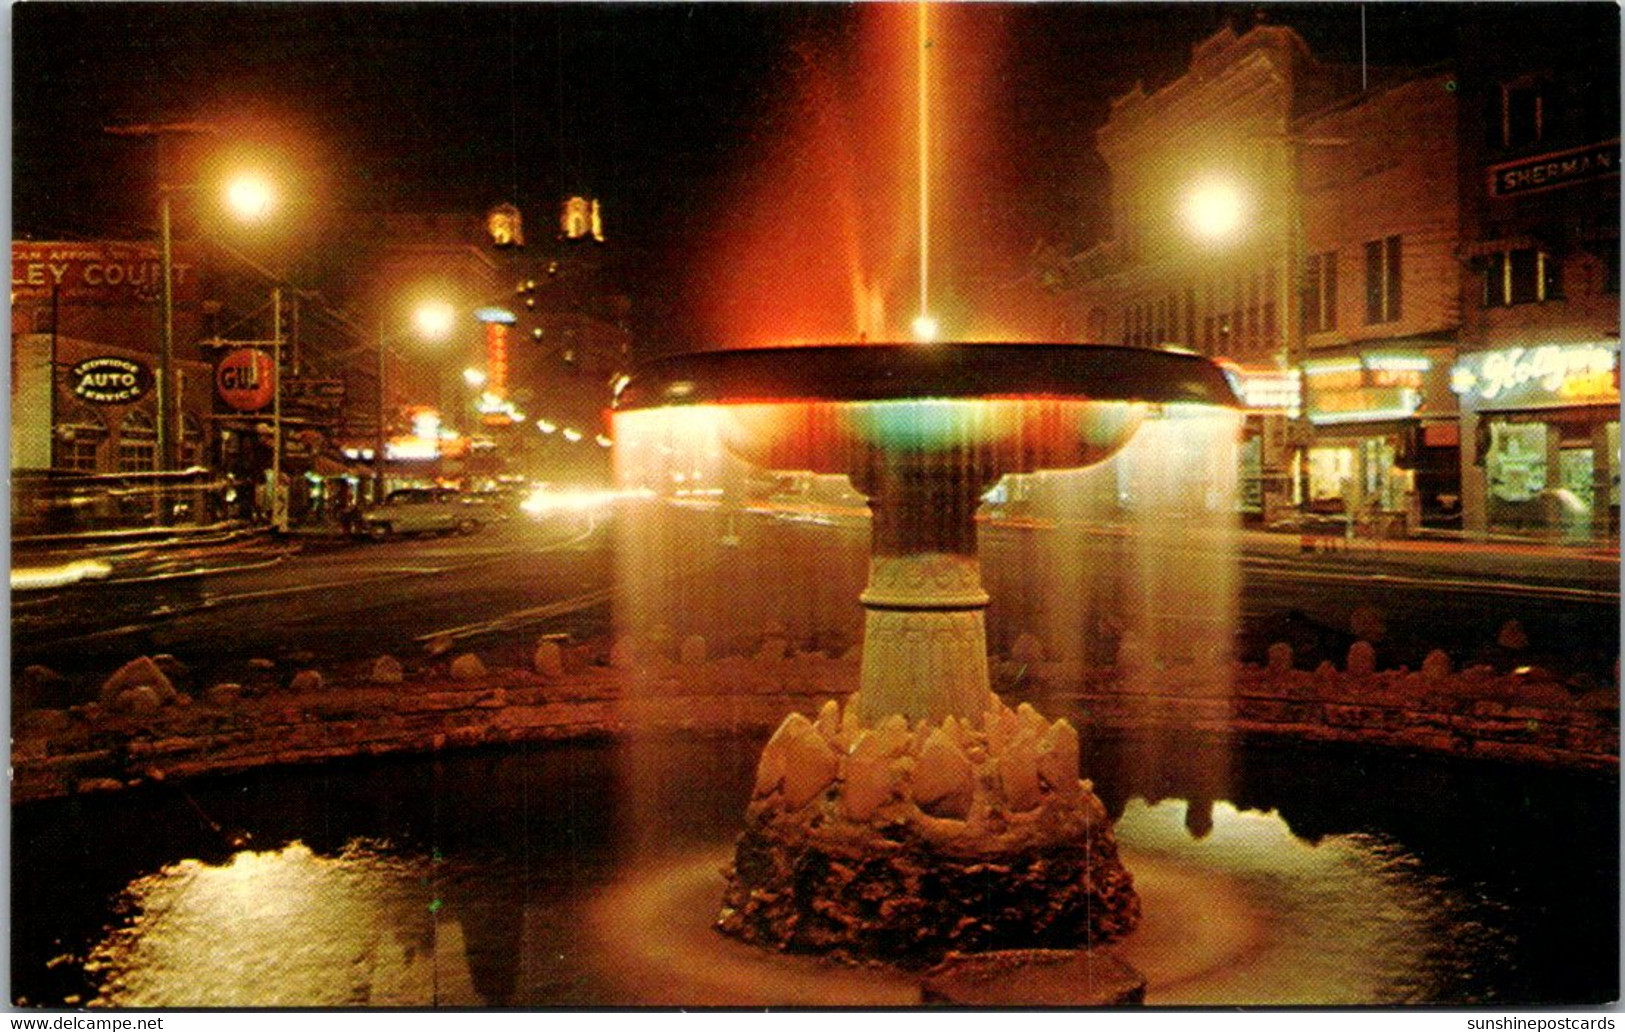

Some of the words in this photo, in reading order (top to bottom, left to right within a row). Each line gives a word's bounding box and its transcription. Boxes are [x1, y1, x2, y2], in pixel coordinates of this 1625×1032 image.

[1503, 154, 1611, 190] SHERMAN
[74, 358, 140, 376] LEDWIDGE
[81, 373, 136, 387] AUTO
[221, 366, 268, 390] GUL
[75, 386, 140, 401] SERVICE
